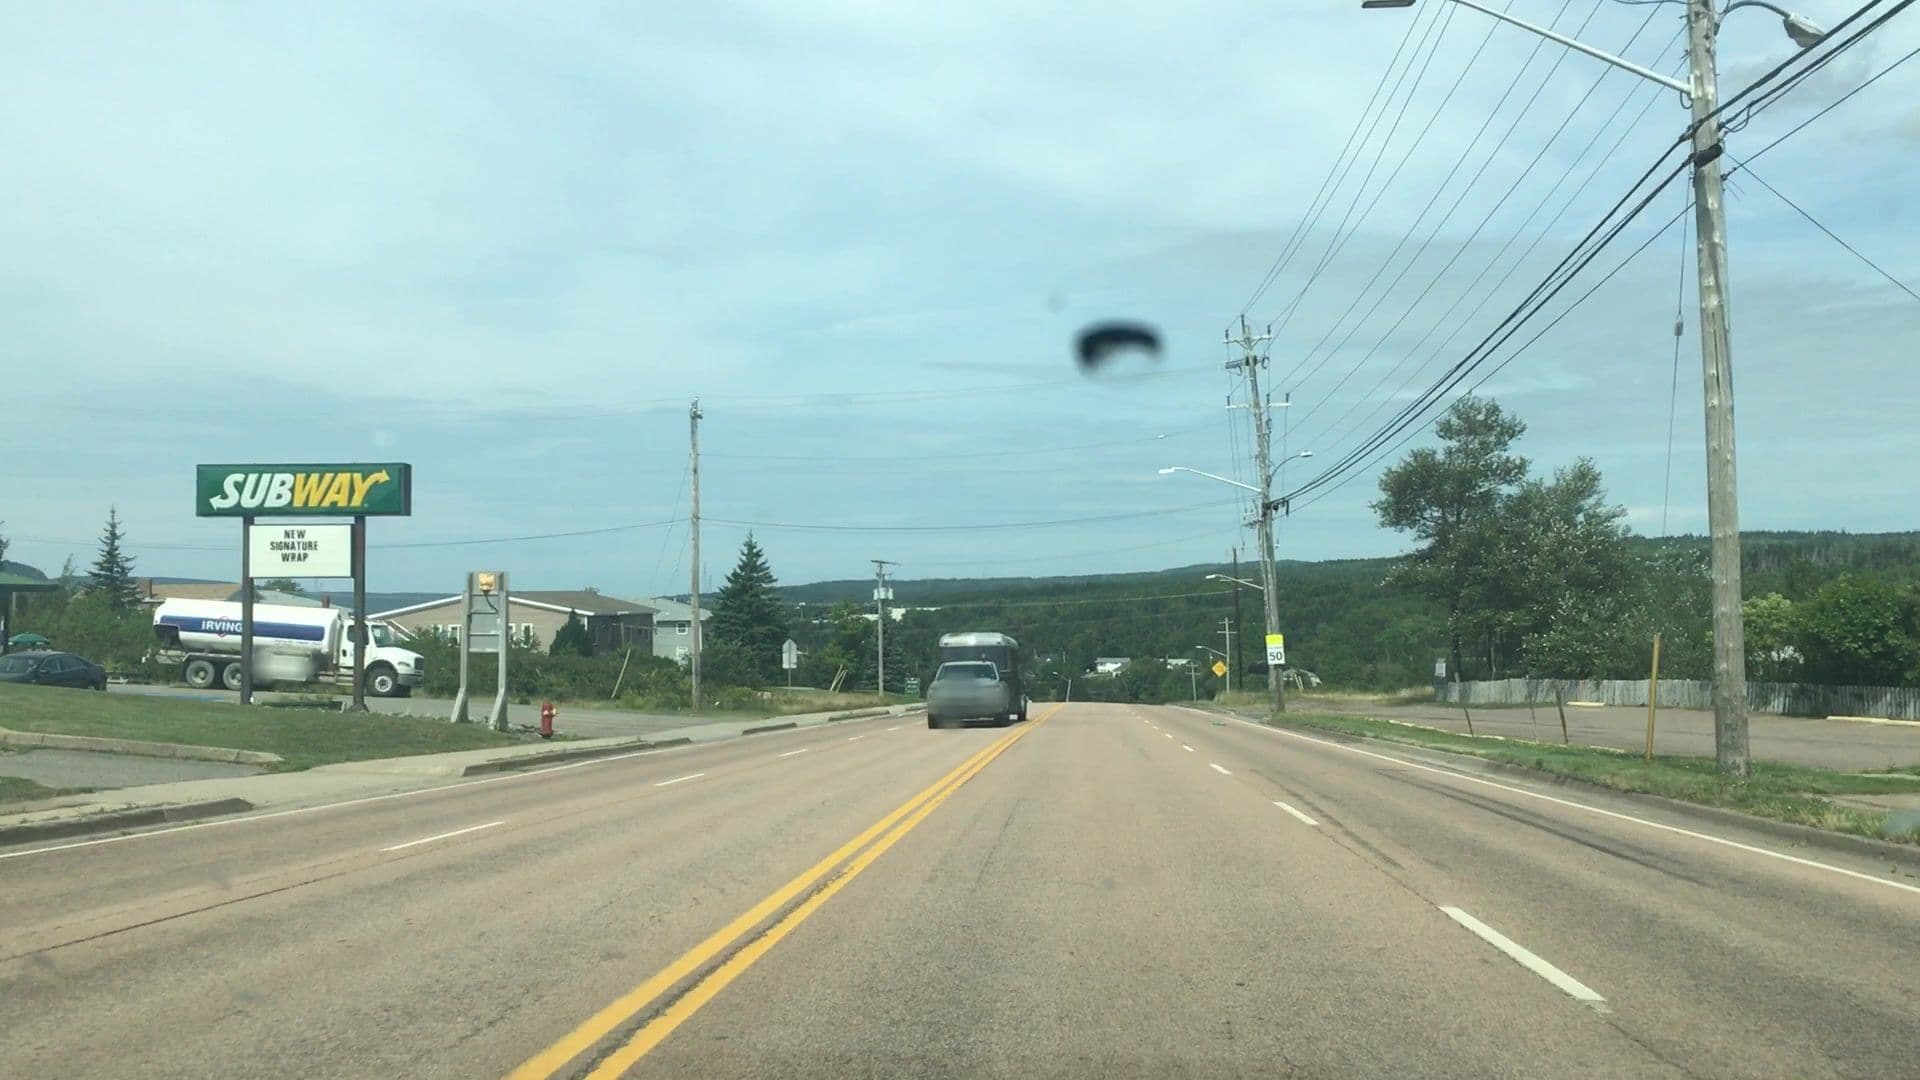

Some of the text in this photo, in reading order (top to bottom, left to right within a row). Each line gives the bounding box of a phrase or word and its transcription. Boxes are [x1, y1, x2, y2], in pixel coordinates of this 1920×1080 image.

[209, 469, 390, 511] SUBWAY
[284, 529, 306, 540] NEW
[270, 541, 319, 551] SIGNATURE
[281, 553, 309, 563] WRAP
[201, 619, 243, 633] IRVING
[1269, 651, 1283, 661] 50
